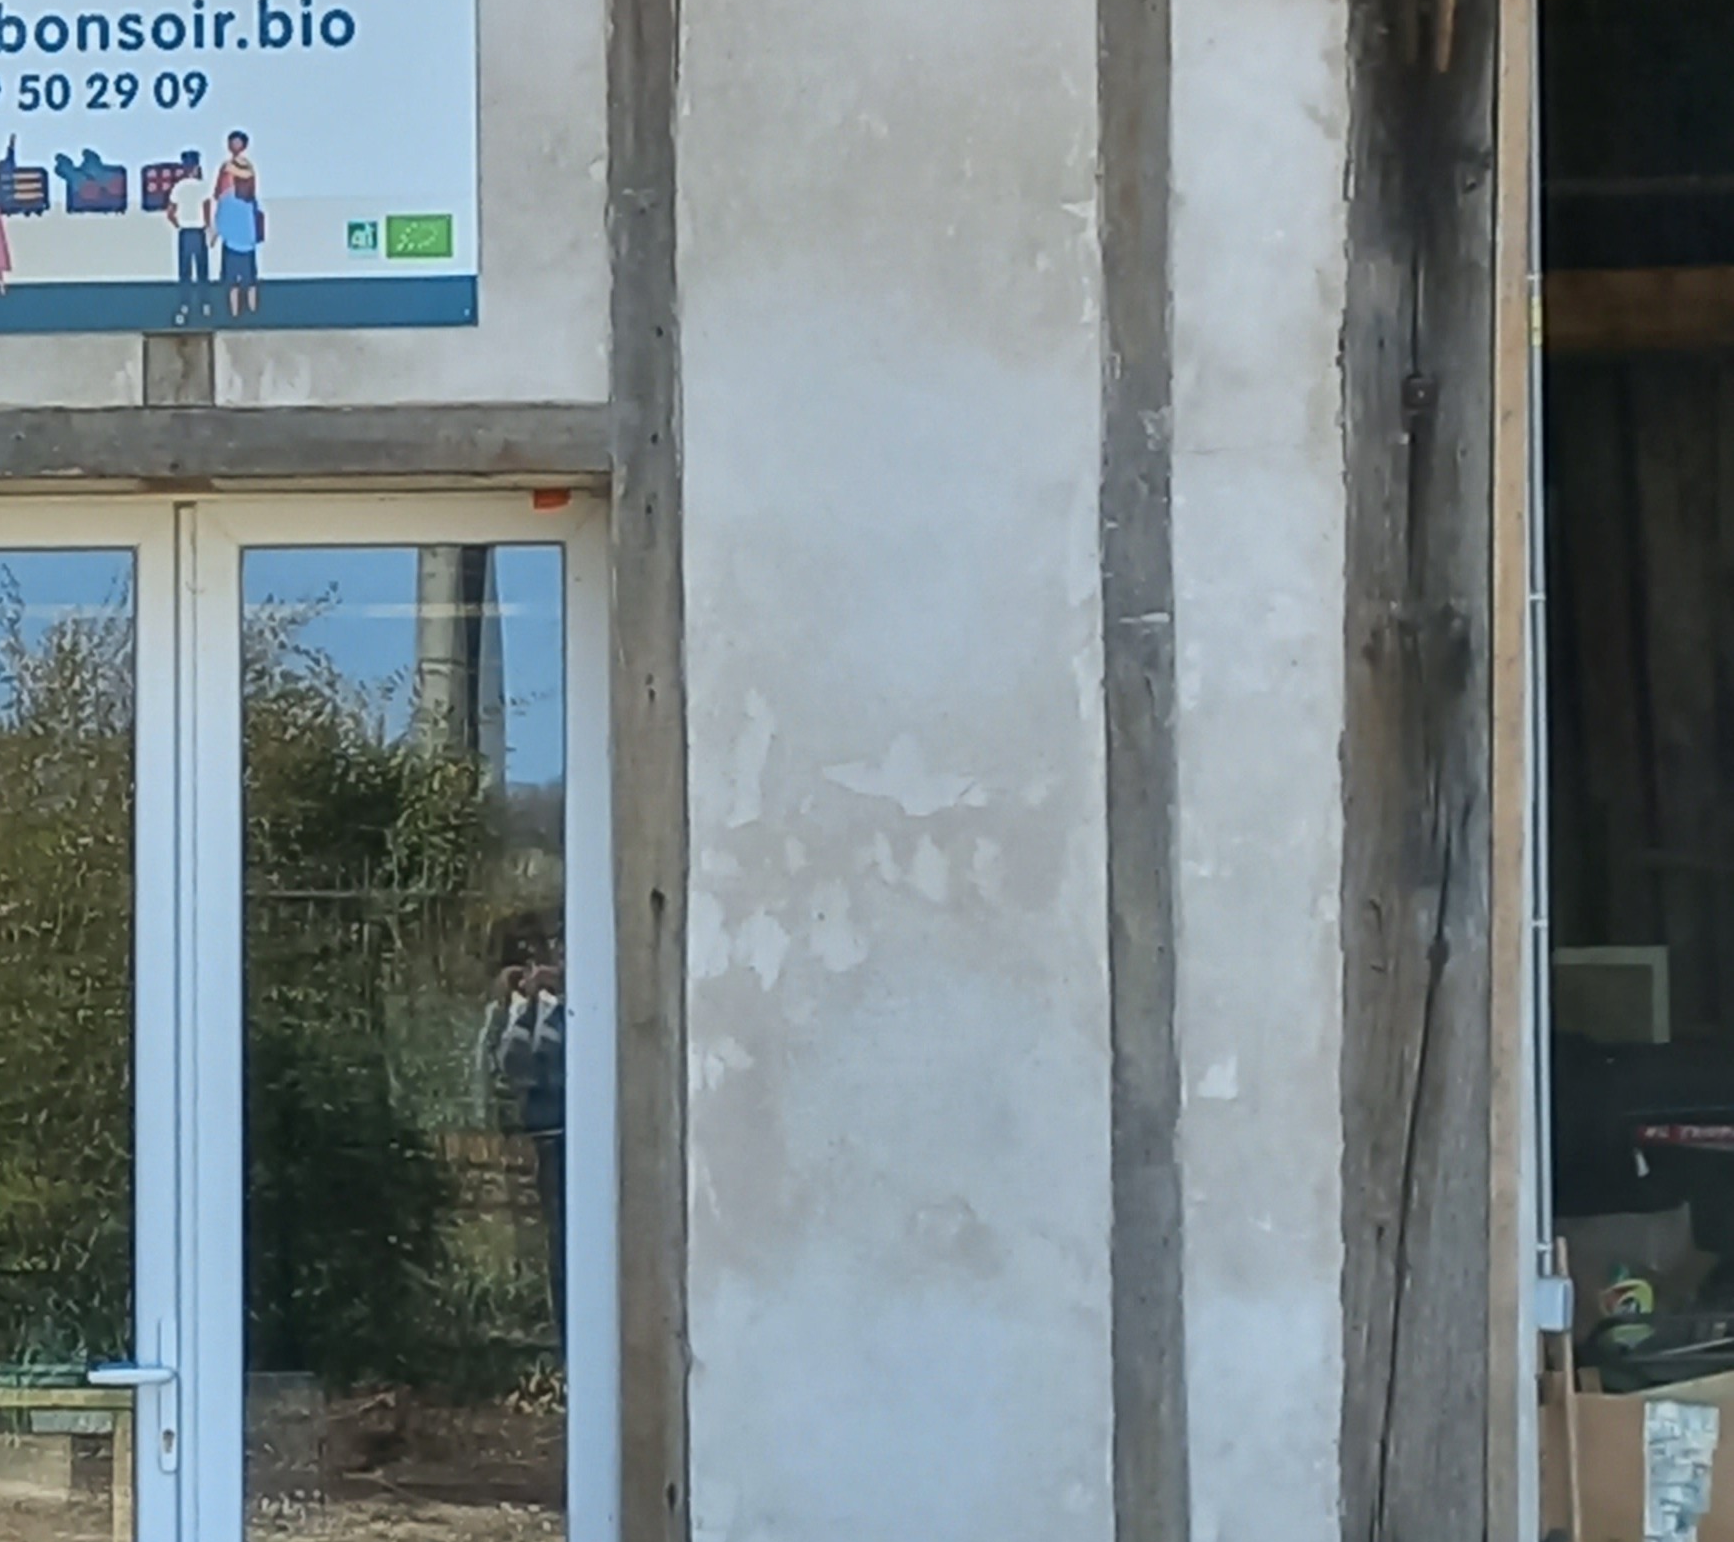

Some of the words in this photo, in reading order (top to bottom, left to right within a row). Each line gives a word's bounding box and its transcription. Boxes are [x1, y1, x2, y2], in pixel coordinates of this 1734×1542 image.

[18, 73, 71, 112] 50
[85, 72, 139, 110] 29
[153, 71, 208, 109] 09
